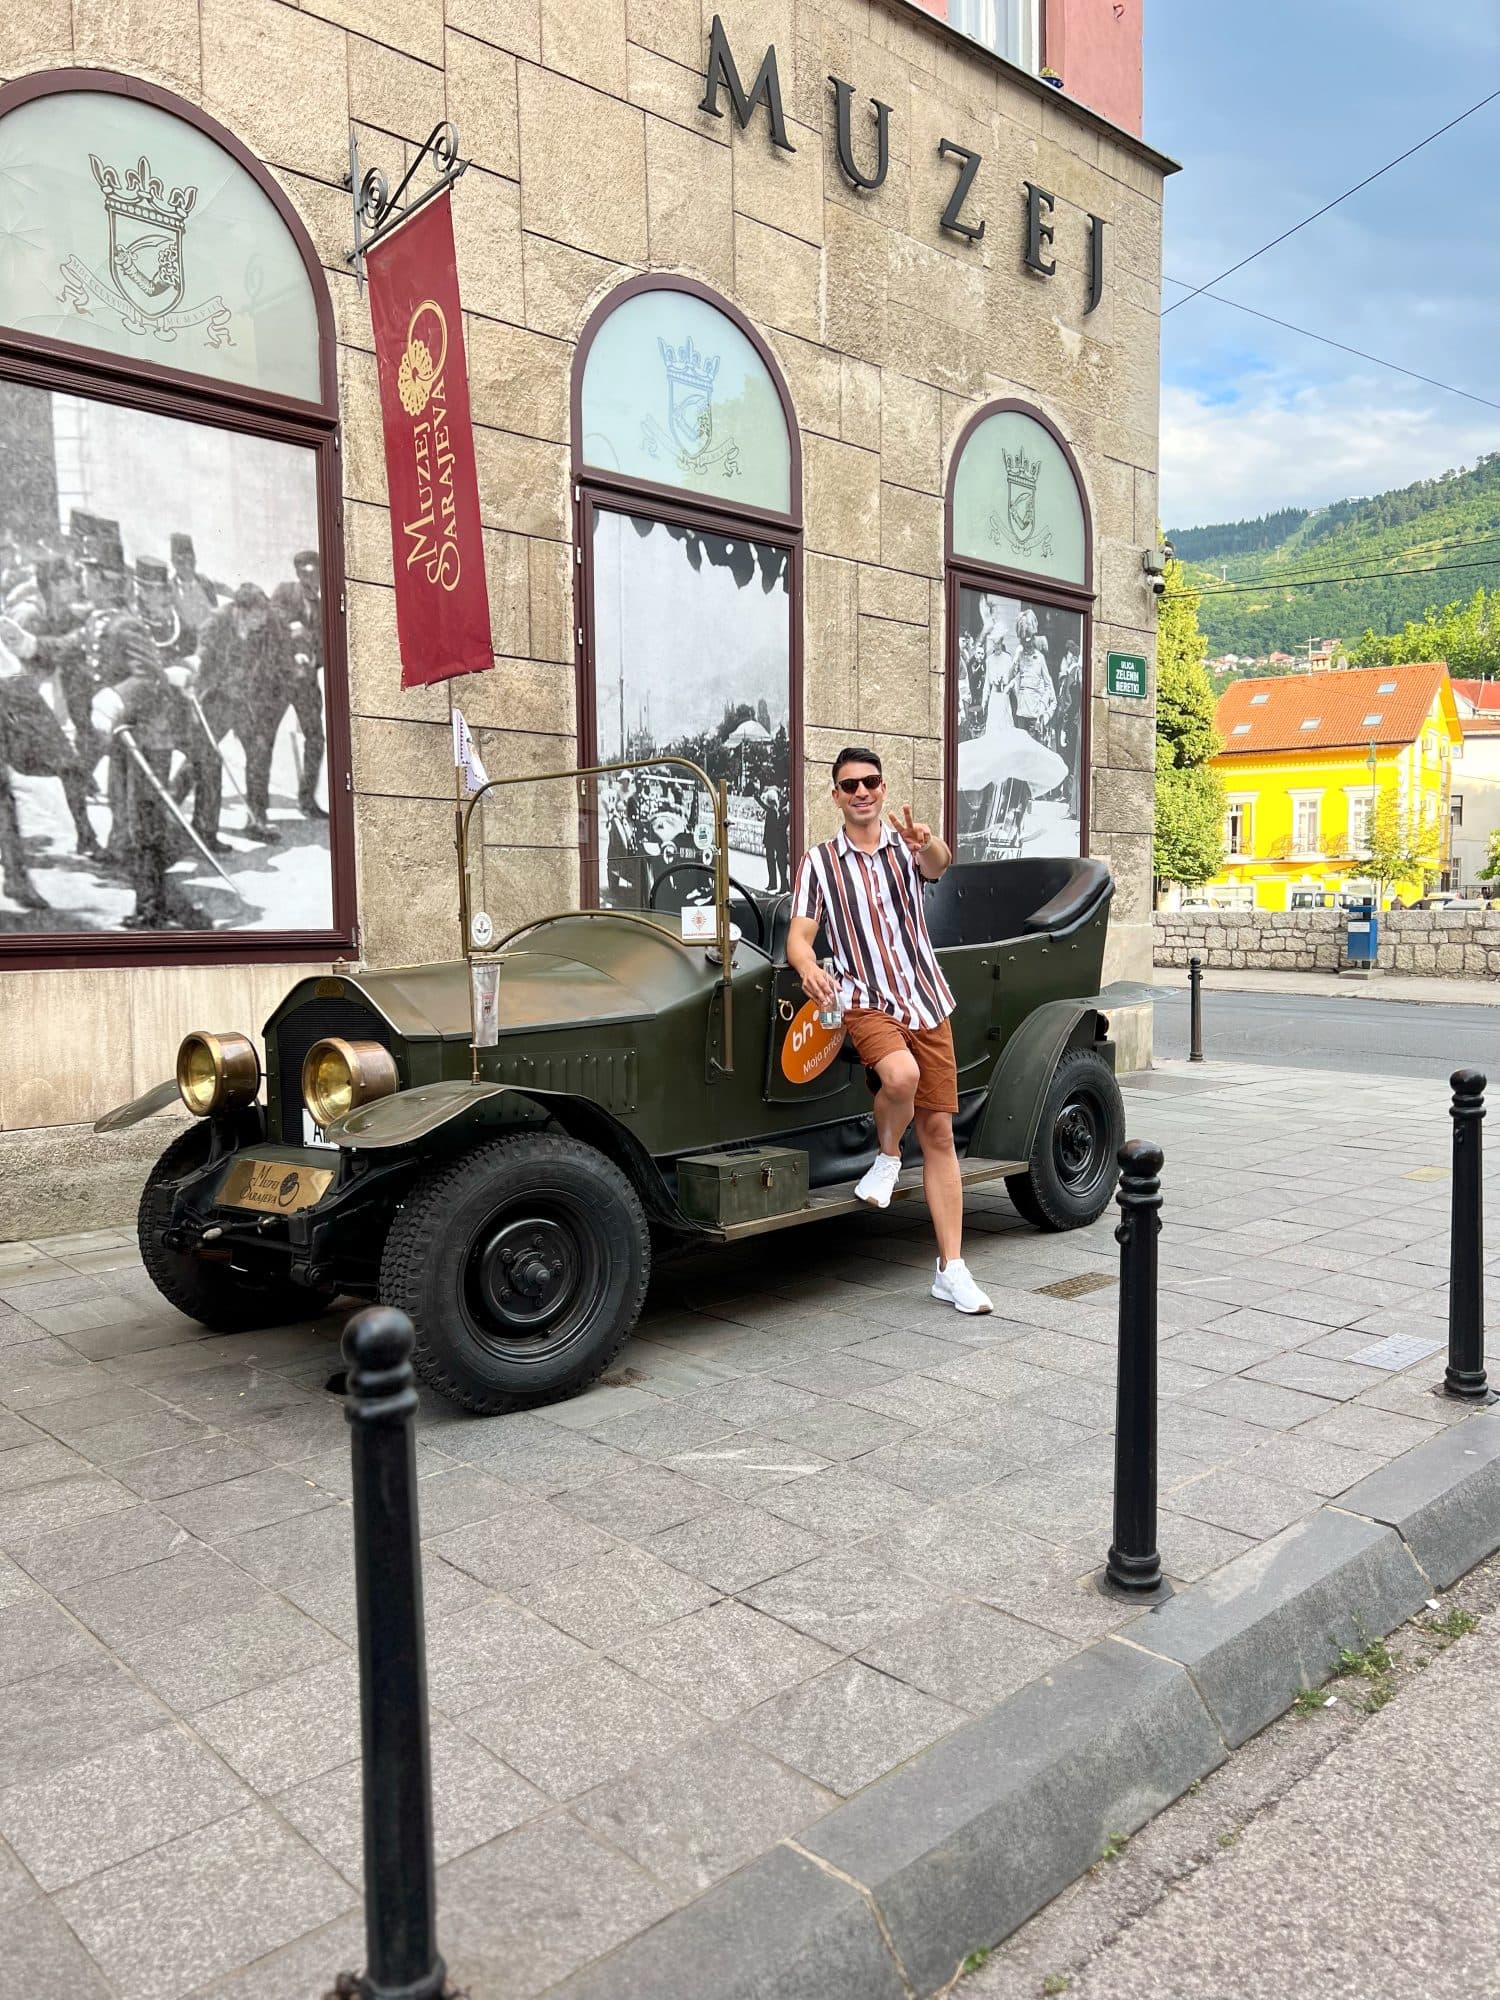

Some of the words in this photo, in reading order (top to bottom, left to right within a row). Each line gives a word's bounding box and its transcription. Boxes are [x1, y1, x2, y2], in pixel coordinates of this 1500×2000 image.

[698, 14, 1114, 316] MUZEJ
[1120, 660, 1136, 671] ULICA
[803, 1051, 823, 1076] Moja
